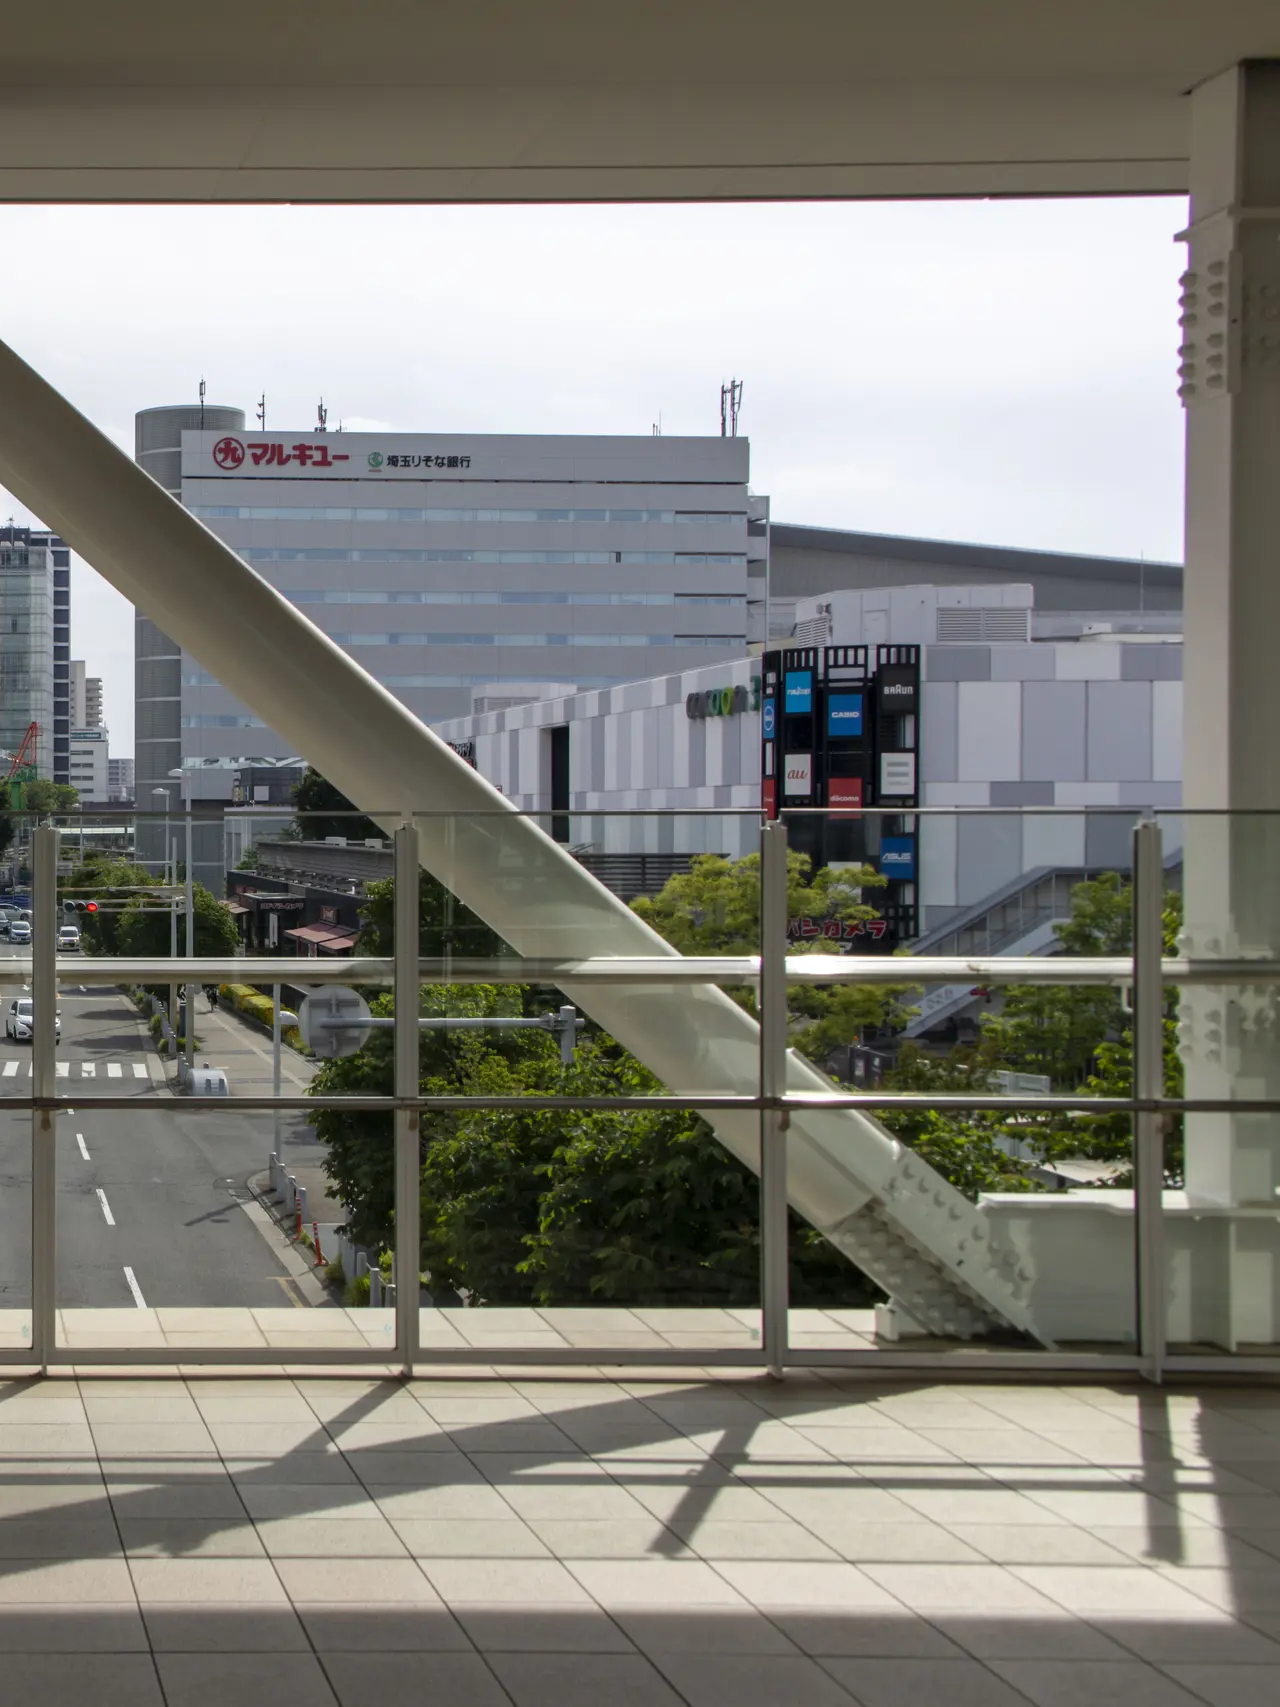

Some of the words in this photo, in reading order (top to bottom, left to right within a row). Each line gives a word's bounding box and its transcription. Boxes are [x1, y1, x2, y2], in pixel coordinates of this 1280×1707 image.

[387, 454, 471, 468] 埼玉りそな銀行
[831, 711, 860, 719] CASIO
[787, 769, 808, 780] au
[882, 852, 912, 862] ASUS
